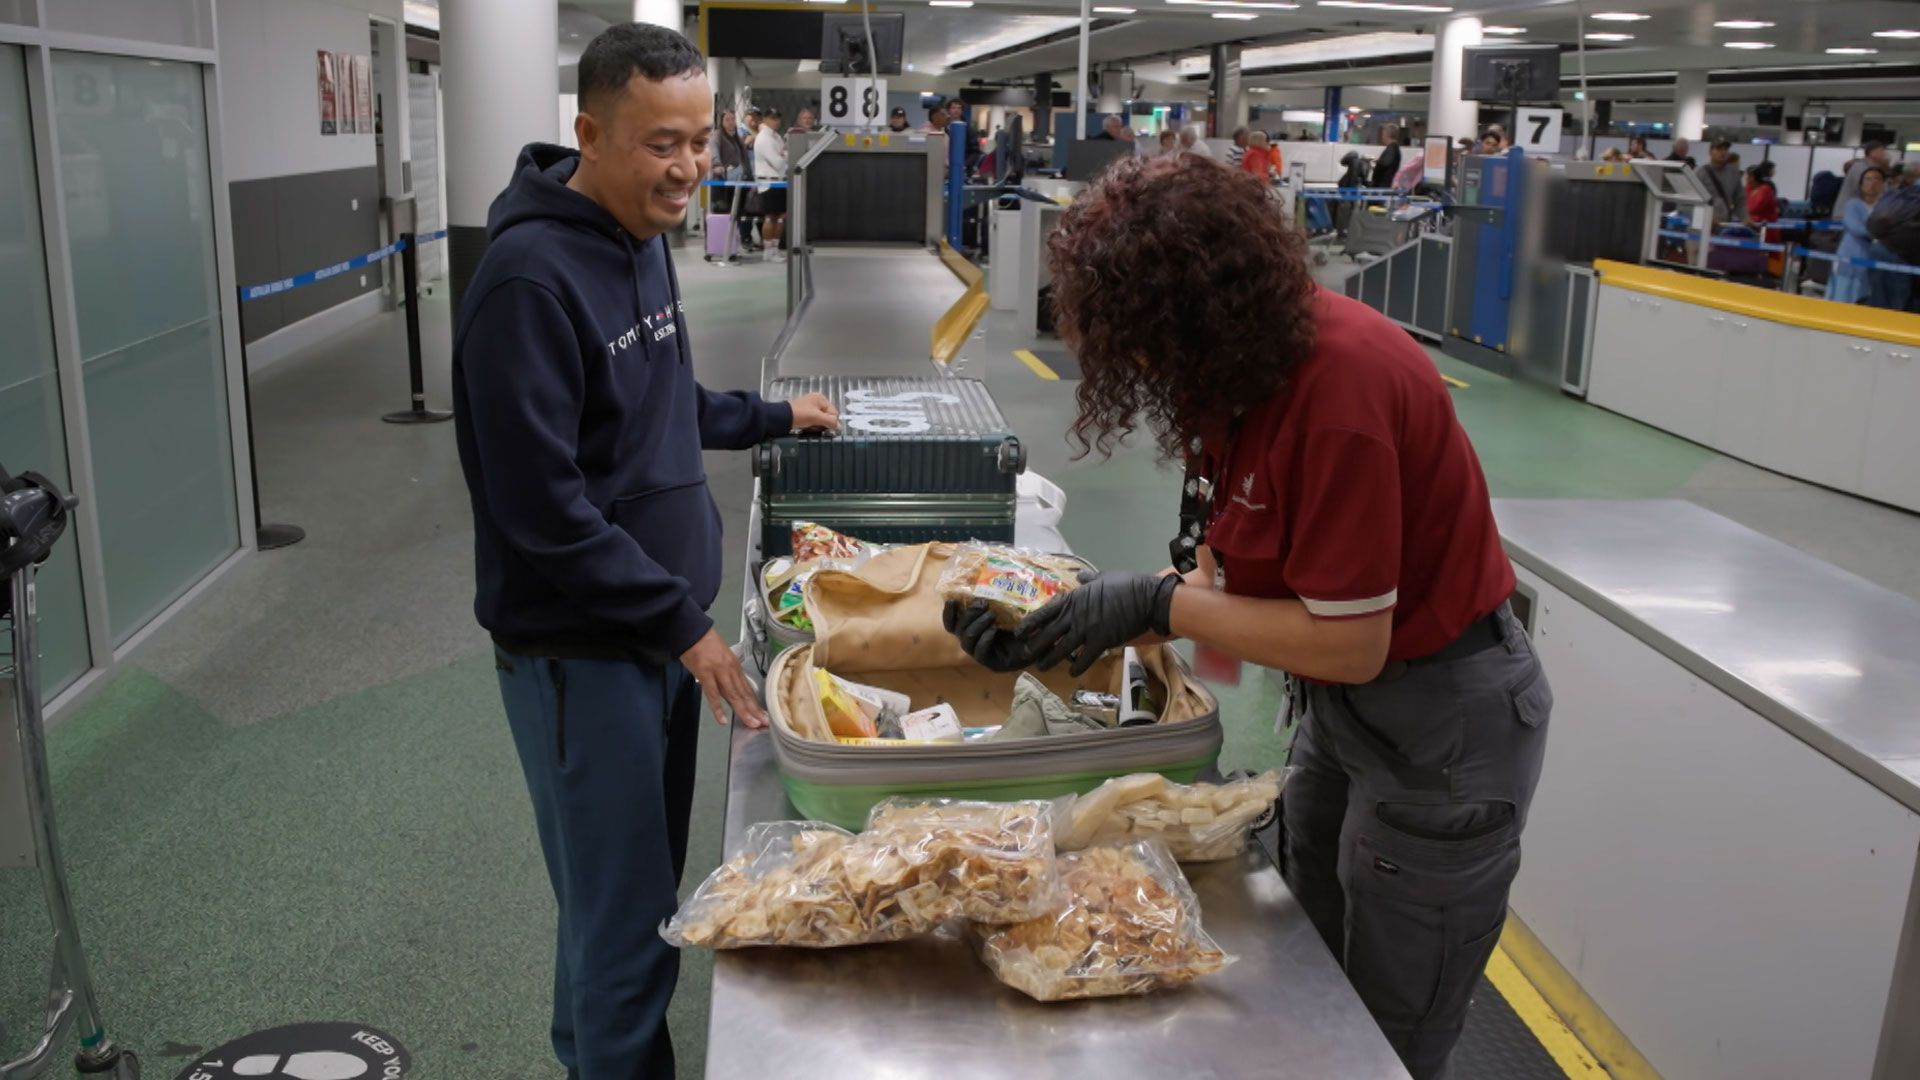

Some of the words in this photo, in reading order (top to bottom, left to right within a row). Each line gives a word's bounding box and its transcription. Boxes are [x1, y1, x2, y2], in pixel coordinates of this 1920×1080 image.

[829, 85, 848, 118] 8
[862, 86, 879, 119] 8
[1528, 115, 1551, 145] 7
[351, 1030, 395, 1055] KEEP
